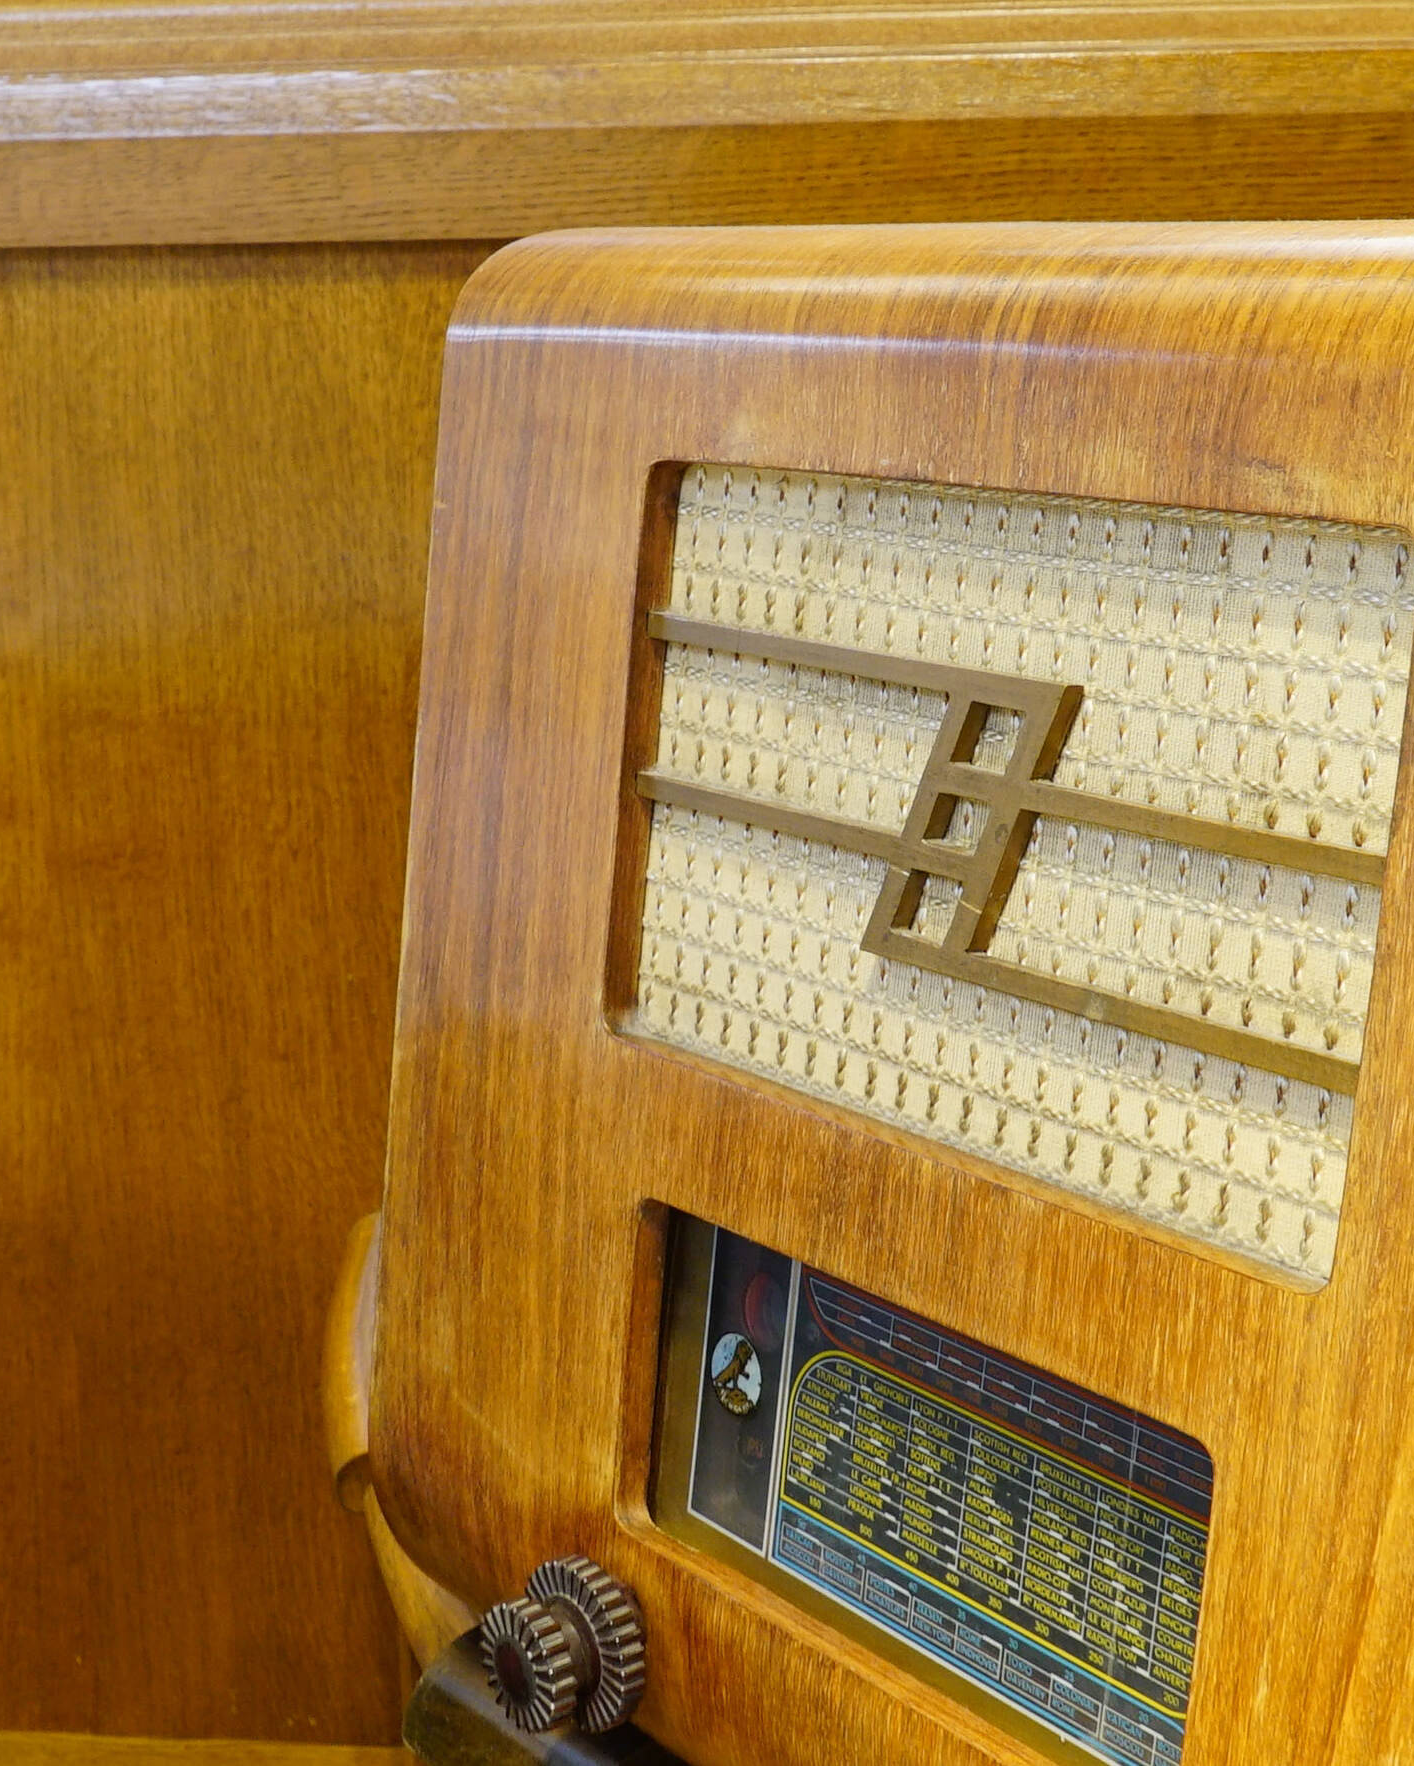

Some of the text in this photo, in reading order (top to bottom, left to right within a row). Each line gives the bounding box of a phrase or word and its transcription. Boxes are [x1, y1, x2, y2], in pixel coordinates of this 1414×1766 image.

[860, 1392, 883, 1409] VIENNE
[875, 1382, 908, 1404] GRENOBLE
[914, 1402, 935, 1421] LYON
[913, 1418, 948, 1441] COLOGNE
[794, 1438, 825, 1462] BOLZANO
[855, 1436, 888, 1461] FLORENCE
[975, 1431, 1009, 1453] SCOTTISH
[852, 1452, 888, 1478] BRUXELLES
[974, 1448, 1011, 1472] TOULOUSE
[850, 1468, 858, 1481] LE
[908, 1464, 927, 1482] PARIS
[1040, 1462, 1081, 1489] BRUXELLES
[849, 1485, 882, 1509] LISBONNE
[905, 1480, 926, 1500] ROME
[1037, 1479, 1096, 1513] POSTE PARISIEN
[847, 1498, 874, 1520] PRAGUE
[904, 1498, 932, 1519] MADRID
[1099, 1508, 1117, 1527] NICE
[1103, 1494, 1139, 1518] LONDRES
[903, 1512, 933, 1535] MUNICH
[965, 1511, 1015, 1546] BERLIN TEGEL
[1032, 1512, 1068, 1536] MIDLAND
[901, 1529, 937, 1556] MARSEILLE
[963, 1527, 1013, 1562] STRASBOURG
[1096, 1544, 1114, 1560] LILLE
[1167, 1541, 1191, 1563] TOUR
[905, 1550, 918, 1564] 450
[961, 1544, 994, 1569] LIMOGES
[1028, 1545, 1066, 1571] SCOTTISH
[945, 1572, 959, 1587] 400
[987, 1595, 1002, 1611] 350
[1089, 1596, 1142, 1631] MONTPELLIER
[1161, 1593, 1192, 1619] BELGES
[1033, 1598, 1081, 1633] NORMANDIE
[1034, 1621, 1049, 1637] 300
[1100, 1617, 1111, 1633] DE
[1114, 1624, 1147, 1651] FRANCE
[1088, 1650, 1103, 1667] 250
[1152, 1664, 1187, 1692] ANVERS
[1162, 1691, 1179, 1711] 200
[1106, 1709, 1142, 1740] VATICAN
